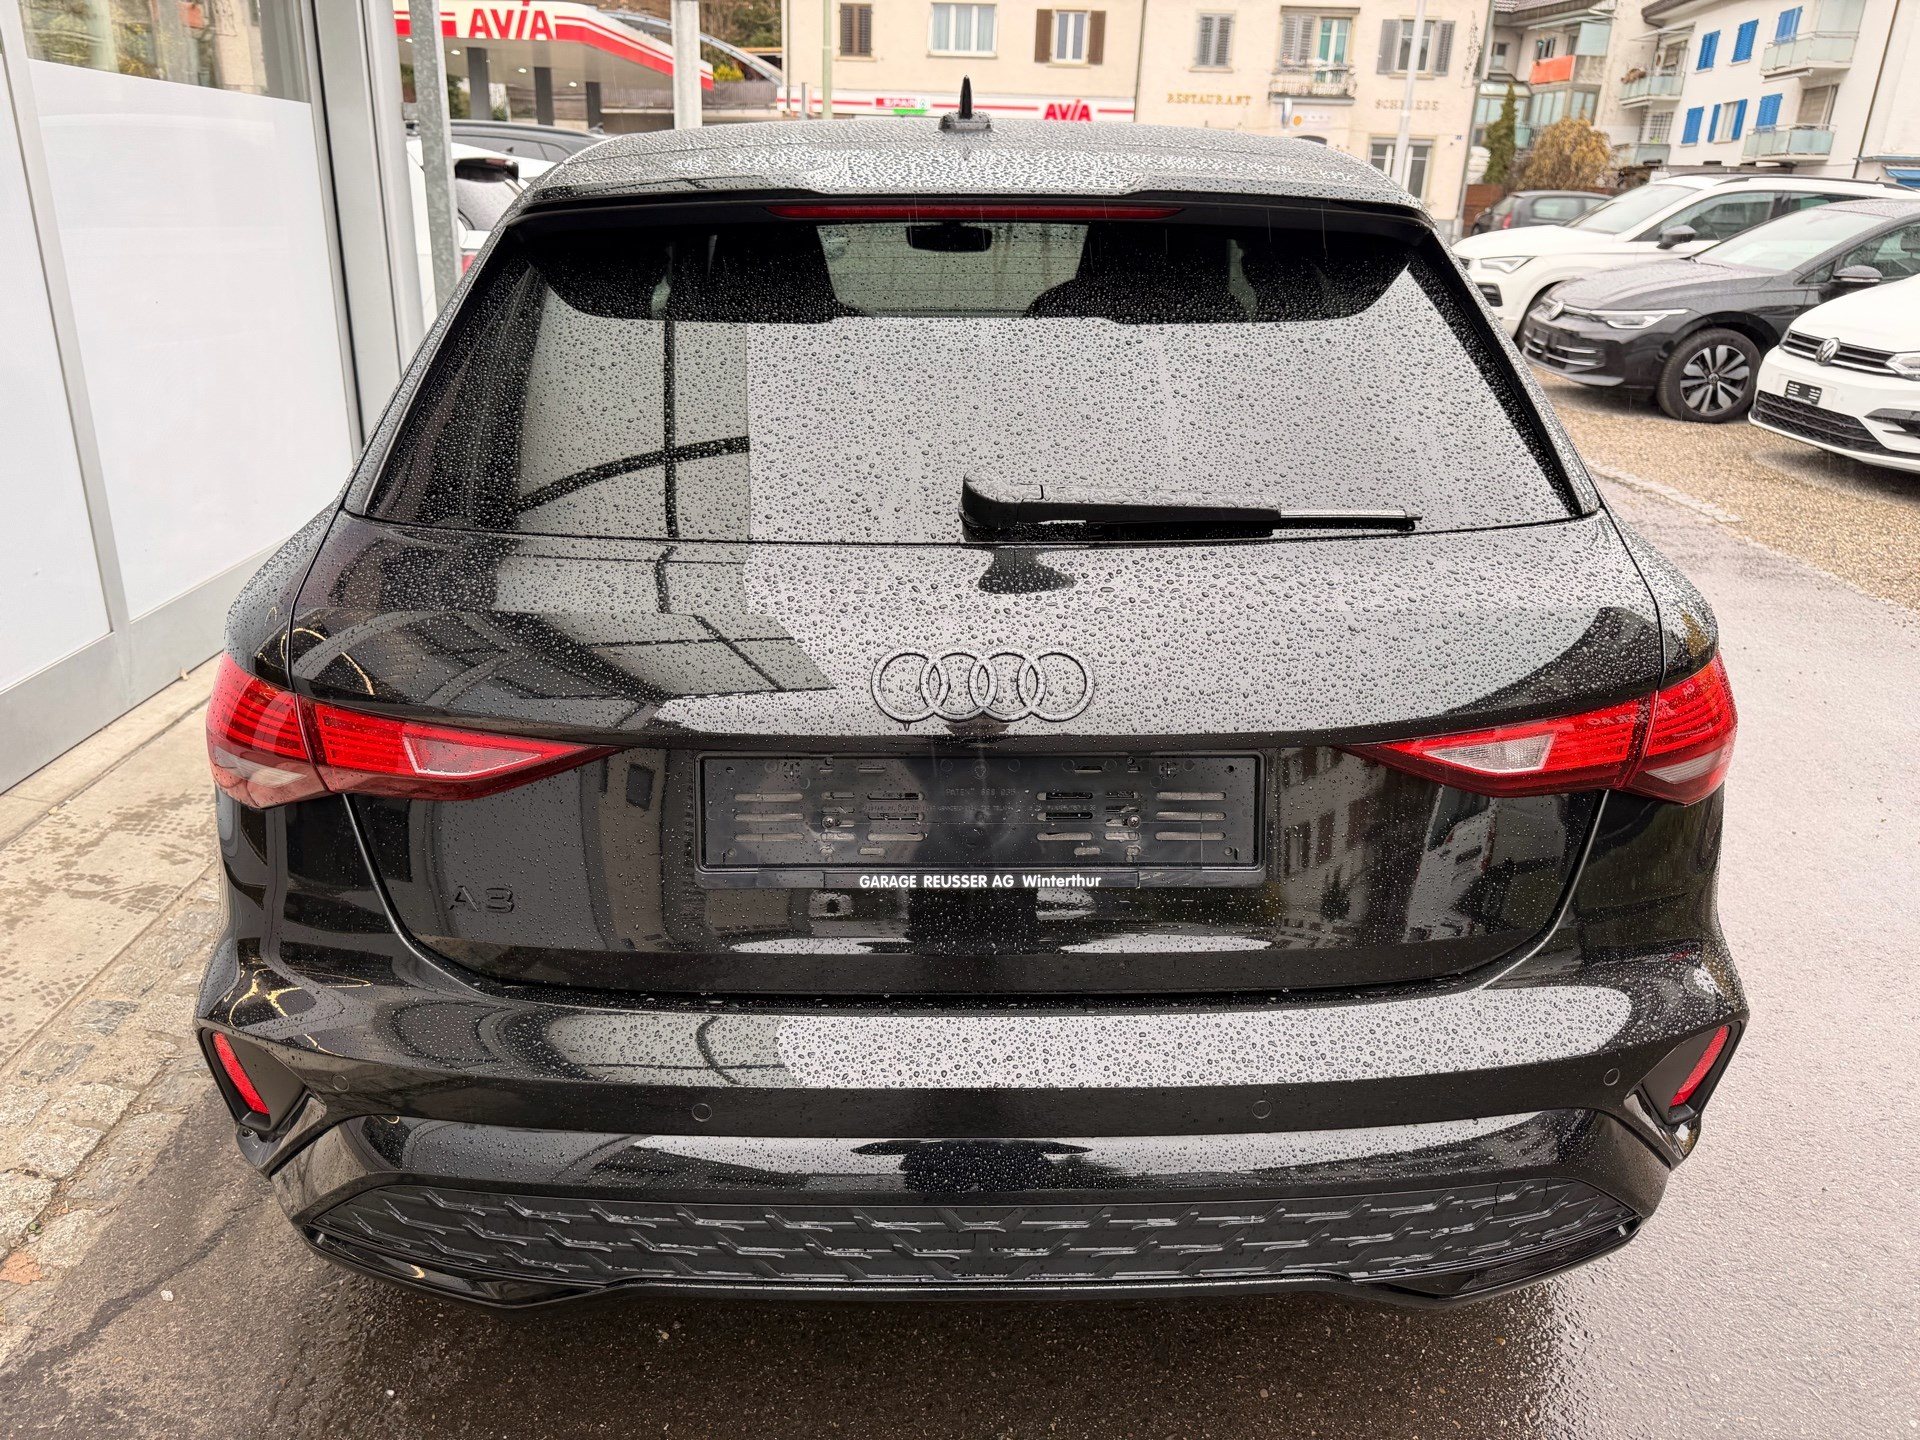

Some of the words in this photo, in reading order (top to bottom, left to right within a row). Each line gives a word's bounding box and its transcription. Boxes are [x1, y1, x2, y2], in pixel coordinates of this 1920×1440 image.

[468, 0, 554, 41] AVIA
[1043, 99, 1092, 121] AVIA
[1166, 92, 1252, 106] RESTAURANT
[859, 874, 917, 889] GARAGE
[923, 874, 988, 889] REUSSER
[992, 874, 1015, 888] AG
[1022, 873, 1102, 888] Winterthur
[449, 885, 515, 914] A3
